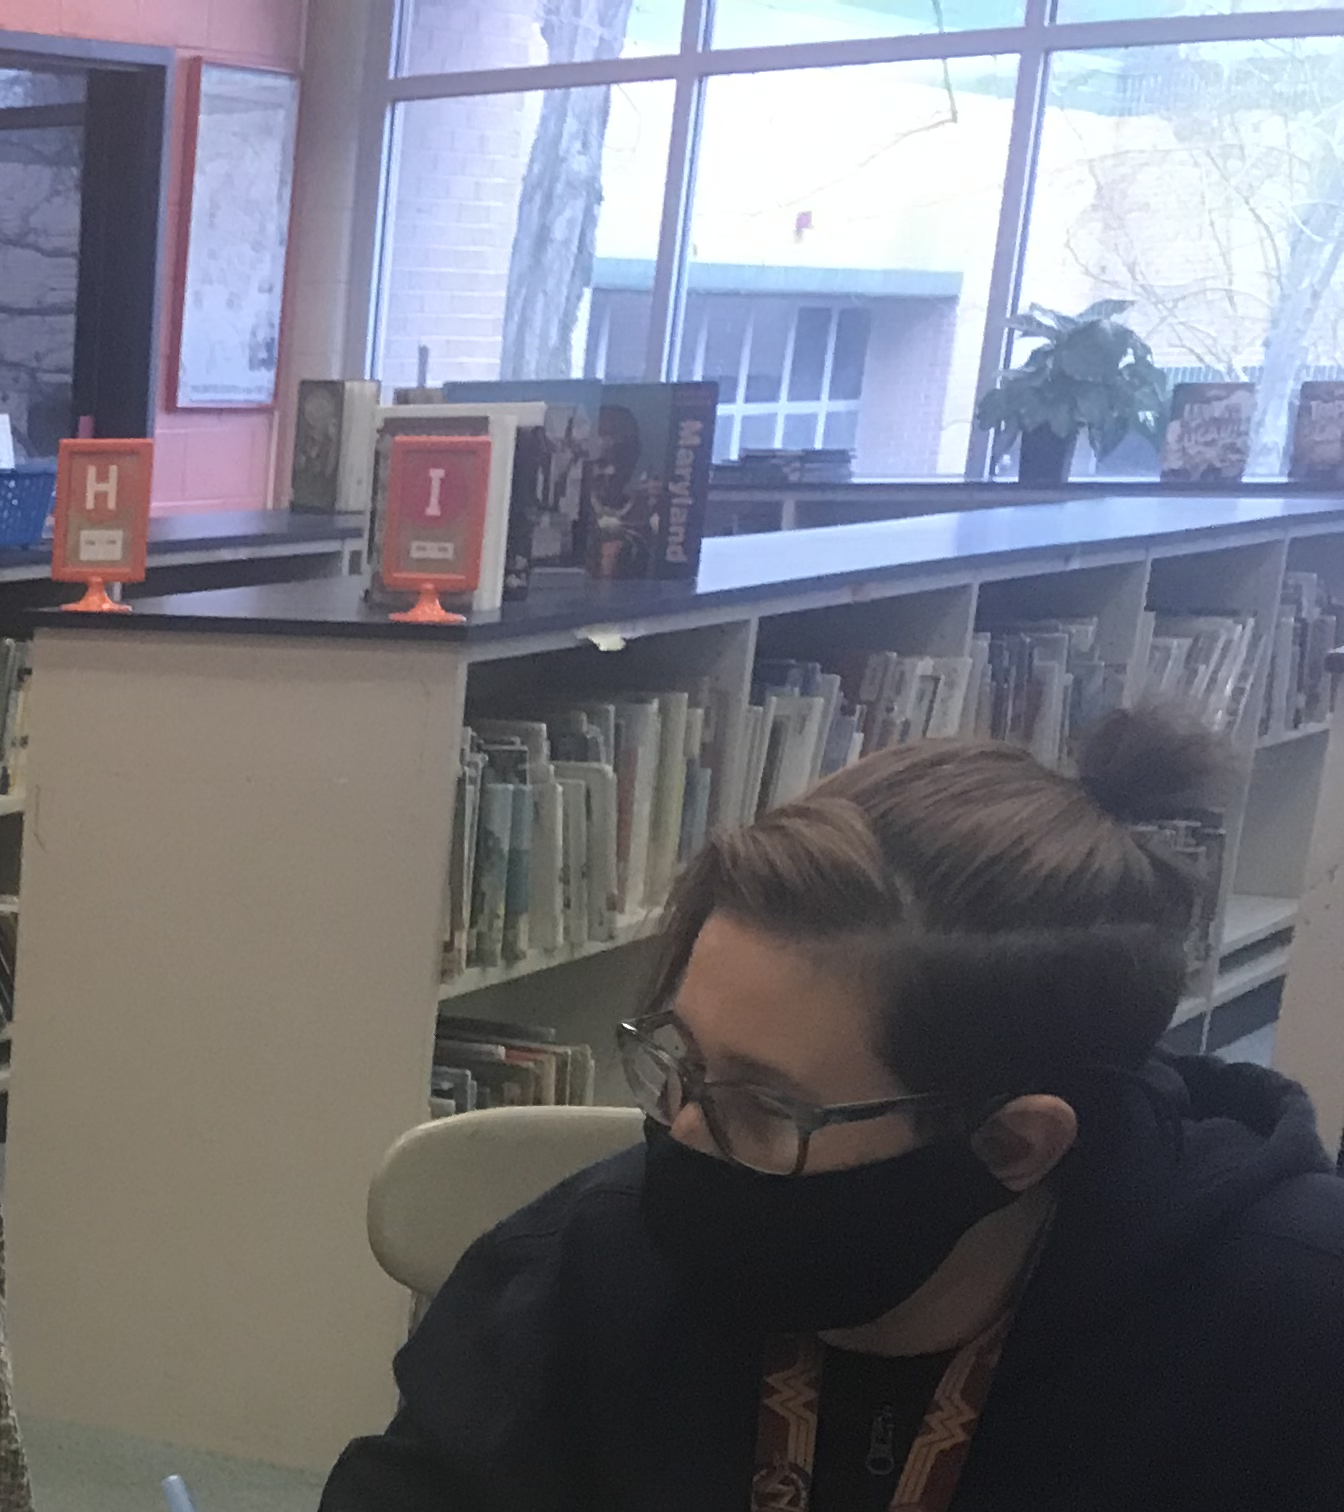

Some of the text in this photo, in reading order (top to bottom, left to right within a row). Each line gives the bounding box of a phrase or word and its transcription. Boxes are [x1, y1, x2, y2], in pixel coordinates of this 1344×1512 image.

[85, 464, 118, 511] H
[425, 467, 446, 517] I
[665, 419, 704, 563] Maryland
